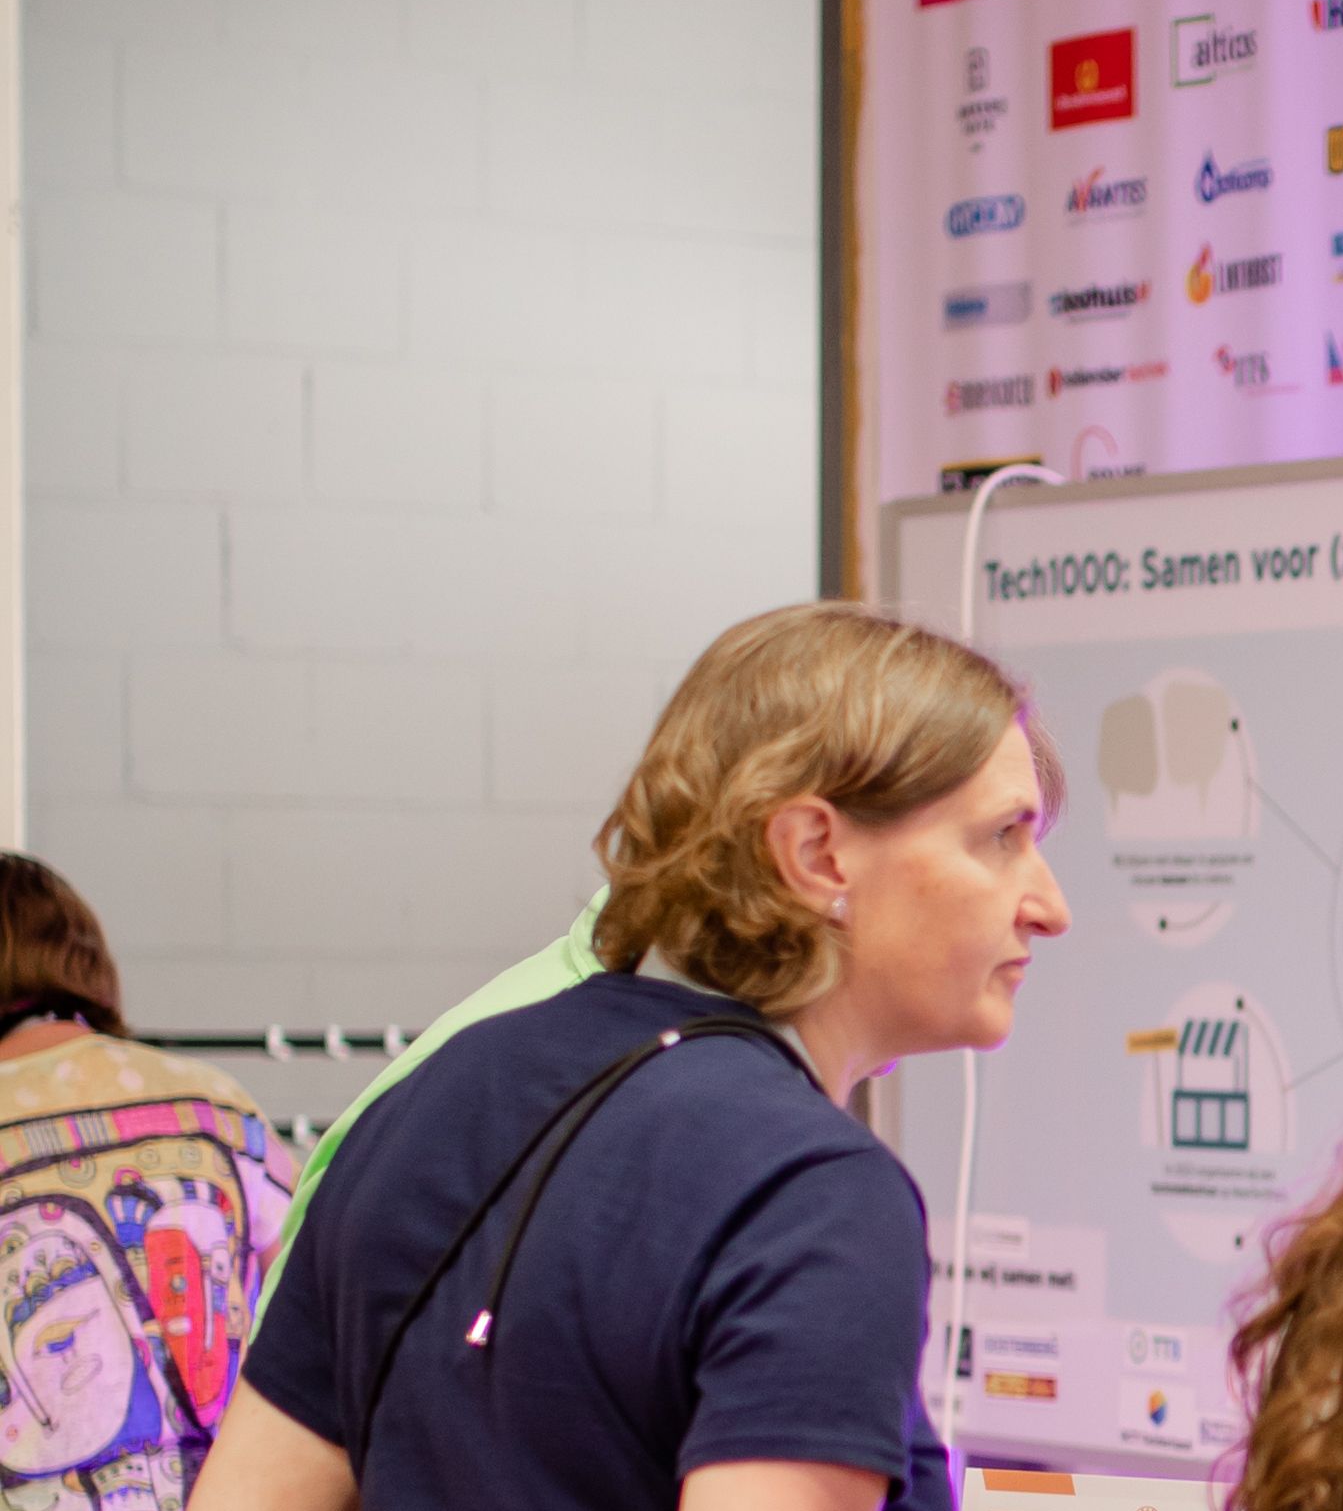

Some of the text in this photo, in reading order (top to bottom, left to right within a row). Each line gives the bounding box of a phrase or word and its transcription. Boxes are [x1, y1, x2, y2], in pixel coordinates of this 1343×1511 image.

[983, 552, 1131, 601] Tech1000:
[1142, 547, 1240, 591] Samen
[1252, 544, 1318, 582] voor
